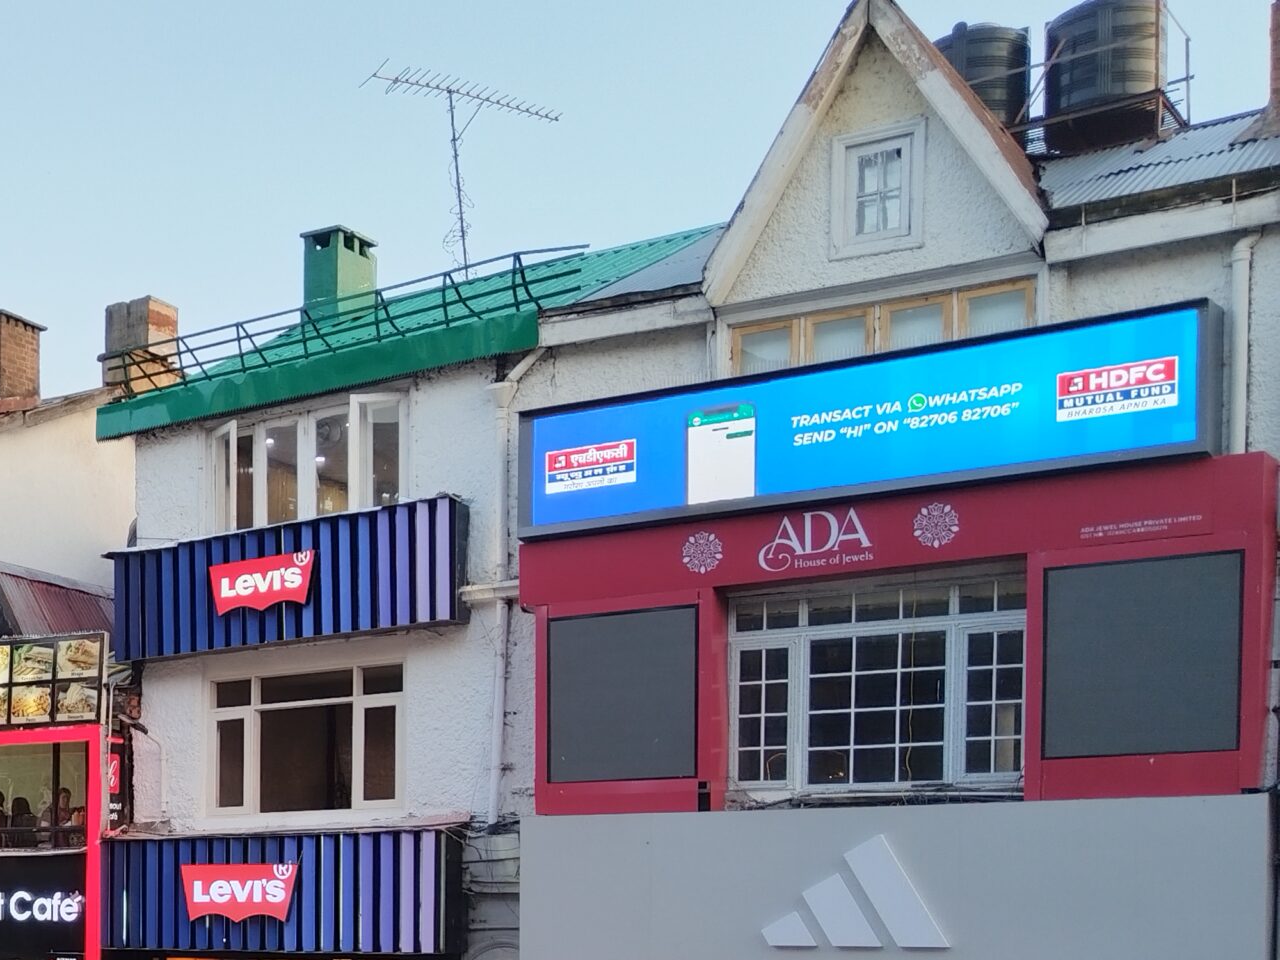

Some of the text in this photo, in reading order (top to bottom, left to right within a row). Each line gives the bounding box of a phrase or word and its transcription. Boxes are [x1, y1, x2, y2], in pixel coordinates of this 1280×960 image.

[1089, 363, 1166, 390] HDFC
[791, 382, 1023, 428] TRANSACT VIA WHATSAPP
[1063, 385, 1172, 408] MUTUAL FUND
[1067, 398, 1167, 418] BHAROSA APNO KA
[793, 429, 836, 446] SEND
[873, 420, 899, 434] ON
[1143, 518, 1172, 526] PRIVATE
[1173, 514, 1203, 523] LIMITED
[758, 507, 873, 572] ADA
[794, 550, 874, 568] House of Jewels
[9, 890, 84, 922] Café
